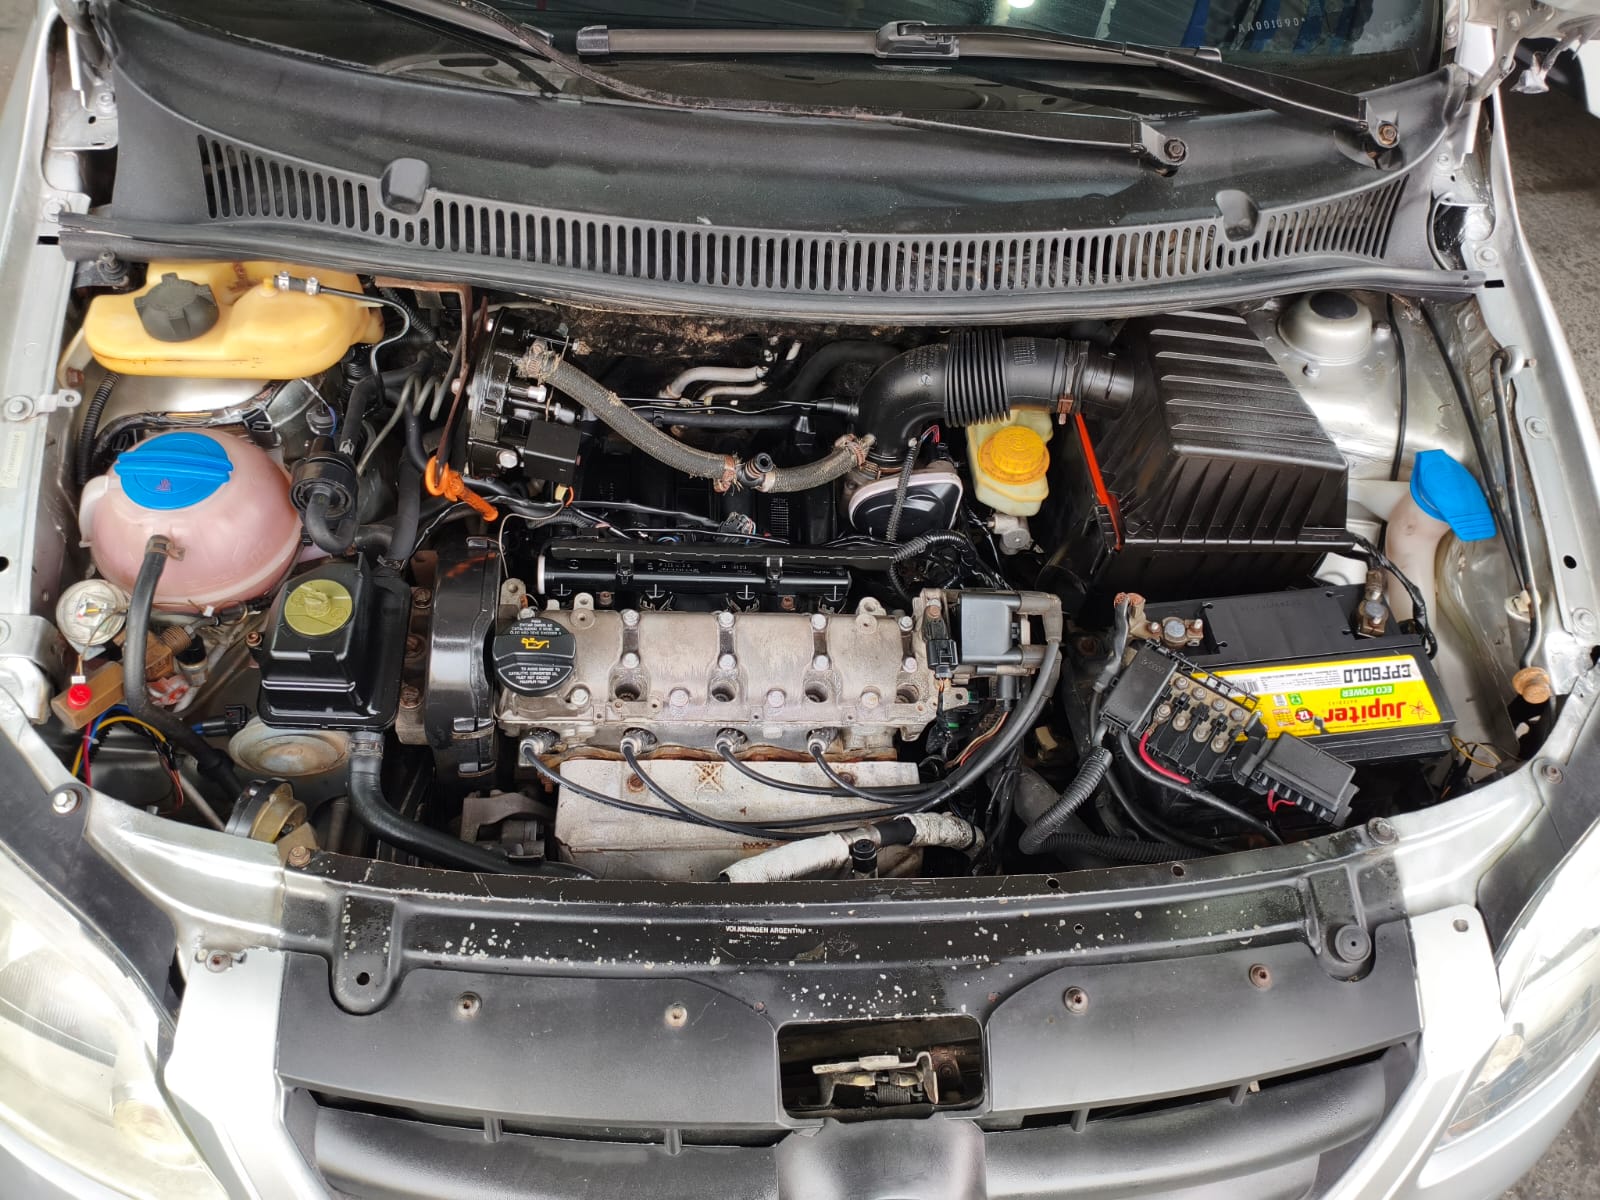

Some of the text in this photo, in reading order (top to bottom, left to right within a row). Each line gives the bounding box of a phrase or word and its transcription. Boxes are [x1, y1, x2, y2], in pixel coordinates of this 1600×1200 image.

[1343, 663, 1412, 684] EPF60LD
[1342, 685, 1393, 698] ECO POWER
[725, 925, 768, 934] VOLKSWAGEN
[770, 926, 806, 935] ARGENTINA
